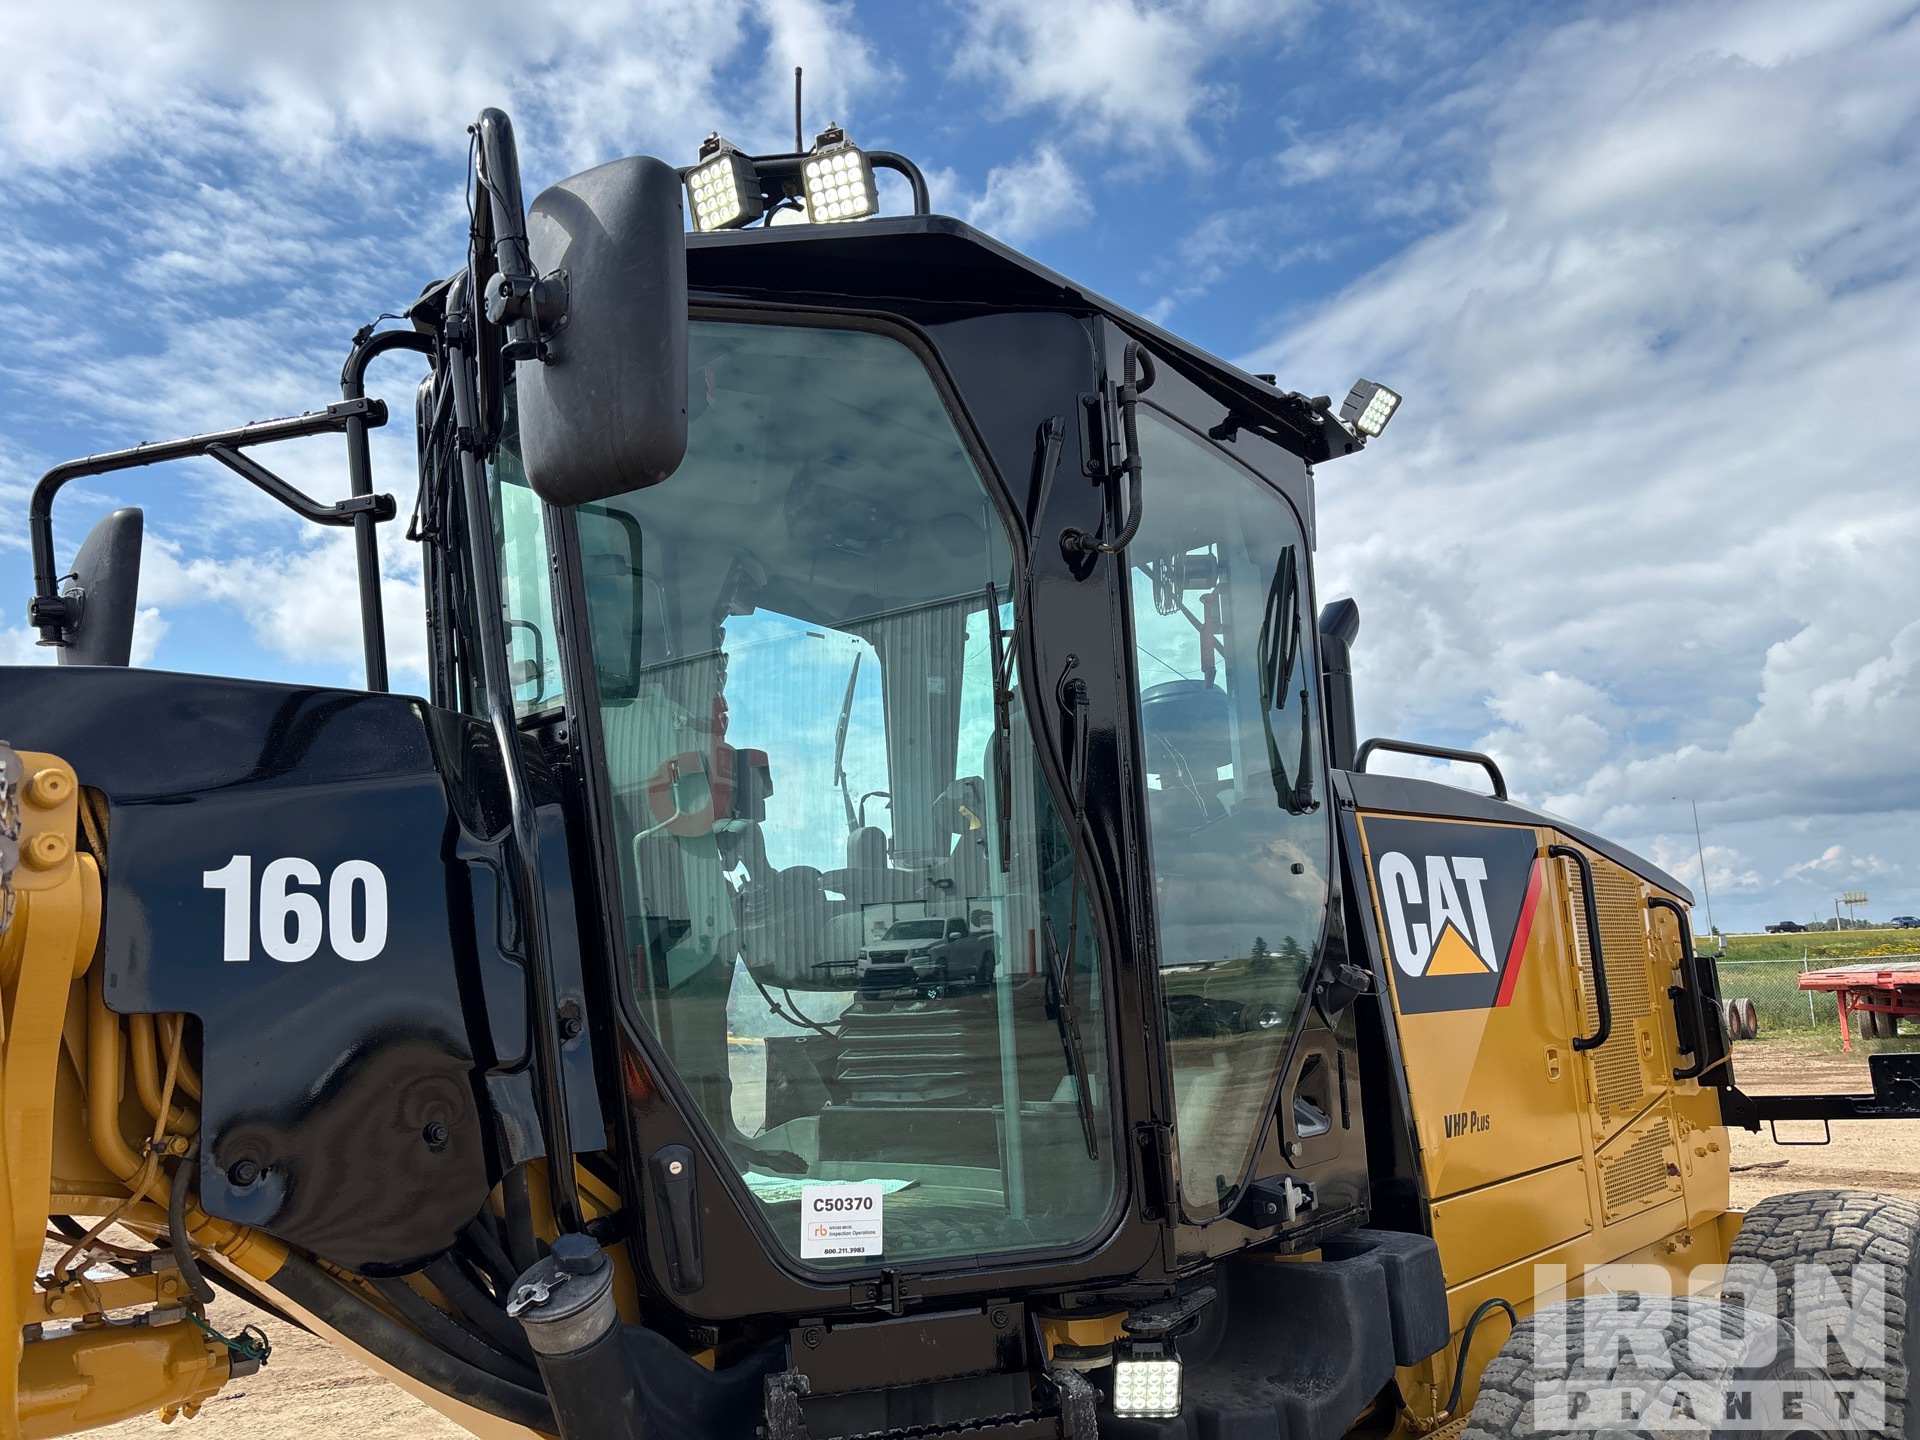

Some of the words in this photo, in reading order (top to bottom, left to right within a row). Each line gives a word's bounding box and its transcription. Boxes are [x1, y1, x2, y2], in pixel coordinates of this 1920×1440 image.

[203, 855, 388, 963] 160
[1379, 851, 1499, 977] CAT
[1444, 1112, 1468, 1139] VHP
[813, 1196, 873, 1212] C50370
[815, 1224, 827, 1236] rb
